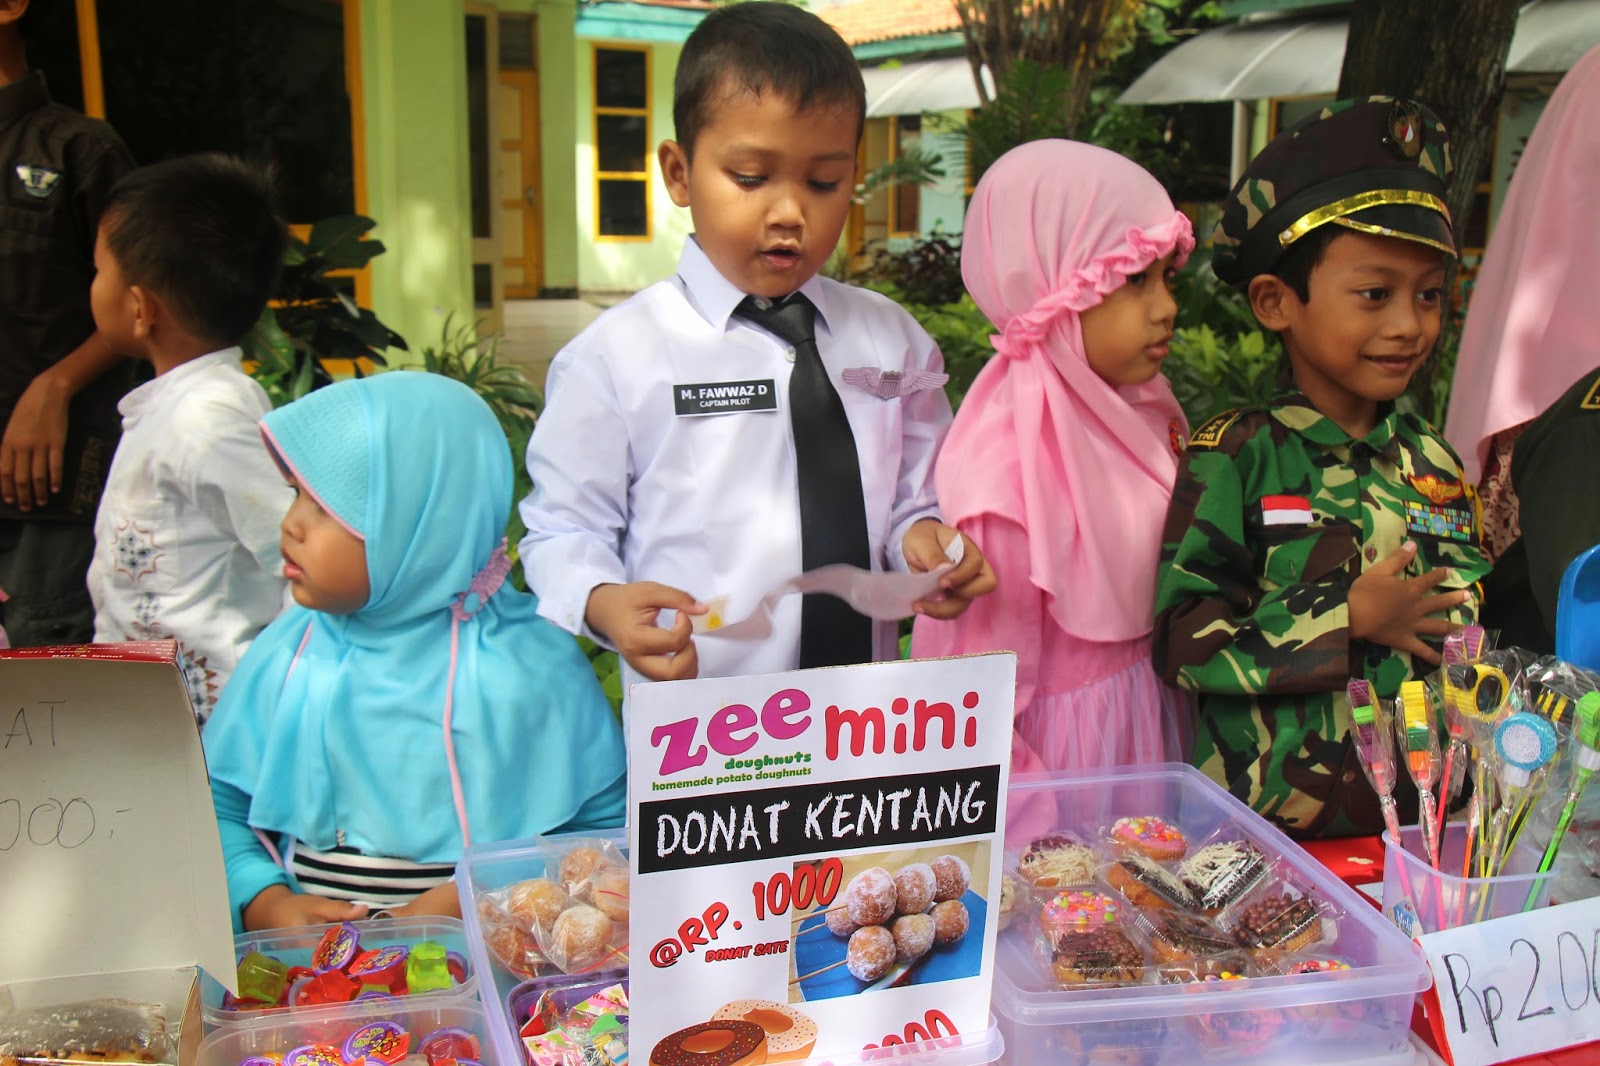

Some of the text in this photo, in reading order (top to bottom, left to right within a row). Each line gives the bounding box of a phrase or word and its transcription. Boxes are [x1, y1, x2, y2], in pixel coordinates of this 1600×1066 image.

[680, 384, 768, 400] M. FAWWAZ D
[699, 398, 751, 408] CAPTAIN PILOT
[1197, 432, 1216, 441] TNI
[824, 691, 980, 761] mini
[724, 751, 812, 771] doughnuts
[652, 767, 812, 791] homemade potato doughnuts
[656, 779, 987, 858] DONAT KENTANG
[752, 857, 844, 921] 1000
[705, 940, 789, 963] DONAT SATE
[1441, 953, 1503, 1047] Rp
